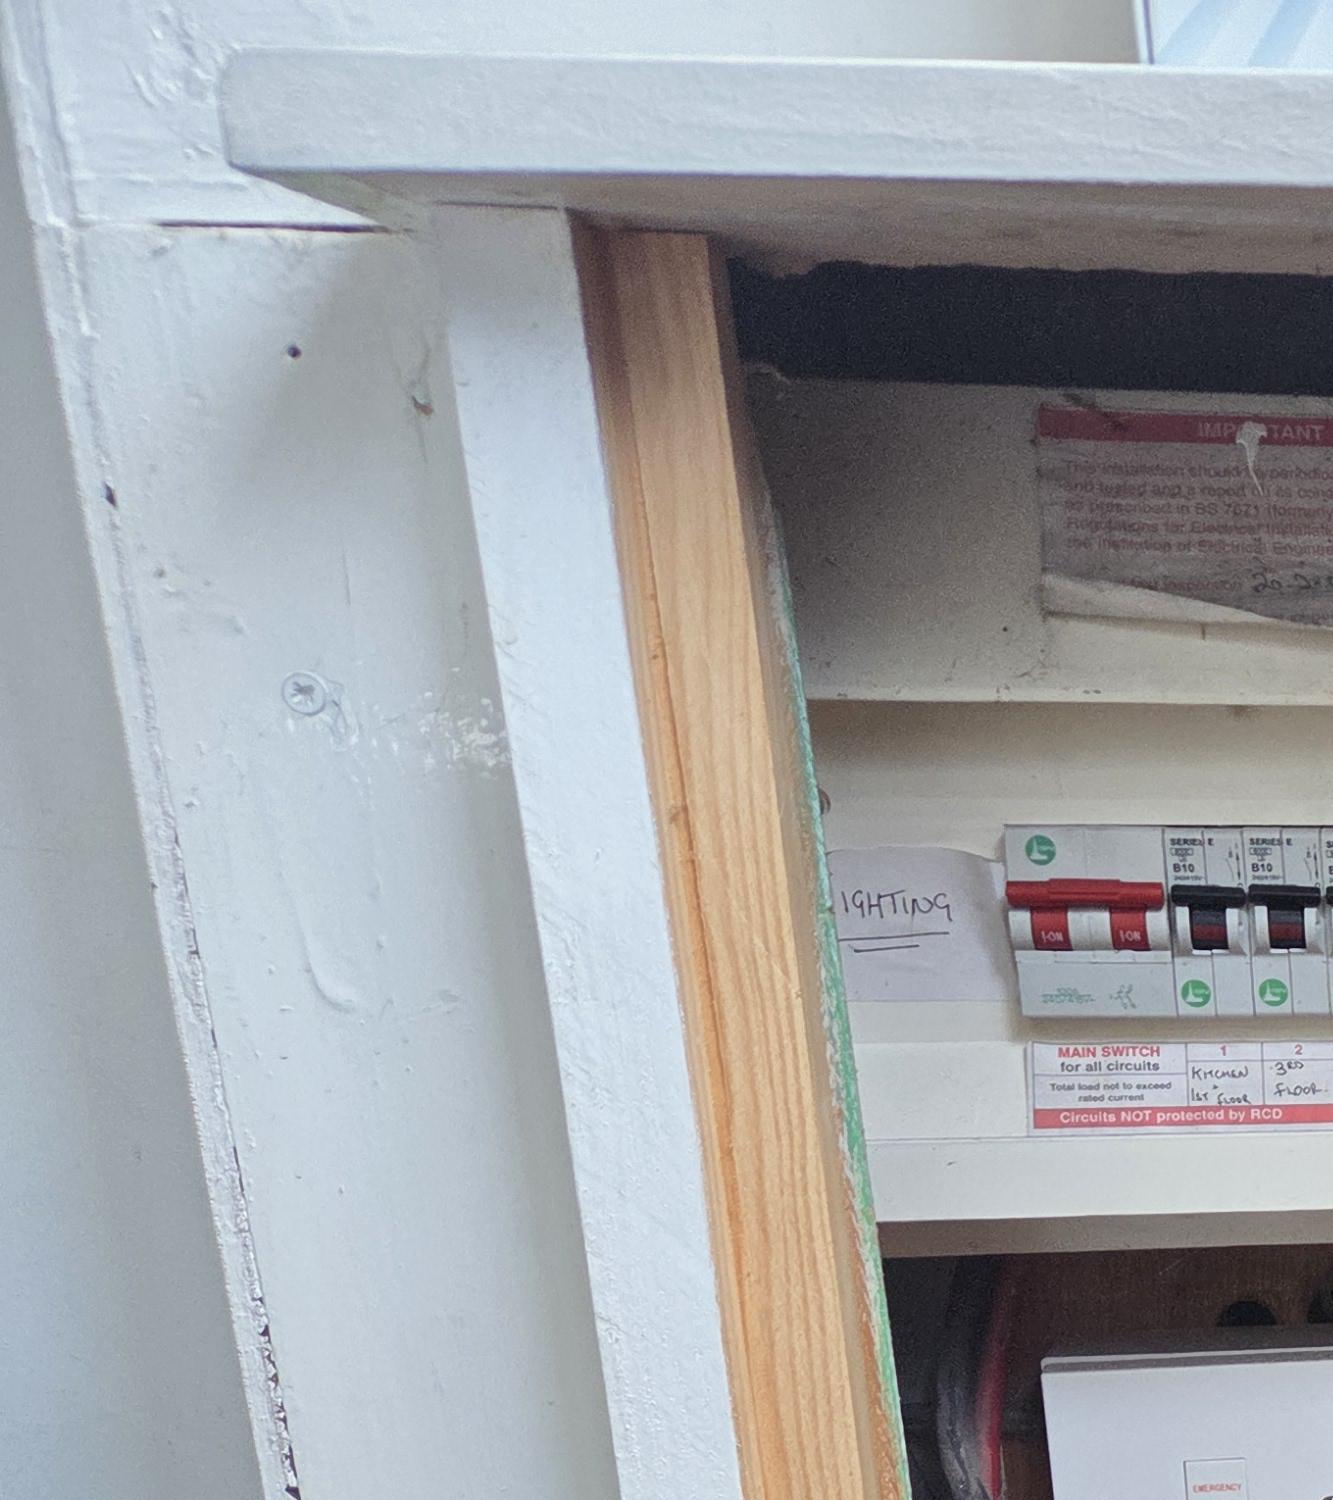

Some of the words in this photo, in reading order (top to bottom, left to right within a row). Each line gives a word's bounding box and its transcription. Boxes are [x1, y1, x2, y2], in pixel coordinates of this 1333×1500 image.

[1199, 422, 1324, 440] IMPTANT
[1173, 864, 1194, 872] B10
[1252, 864, 1273, 872] B10
[842, 889, 952, 922] IGHTING
[1058, 1046, 1097, 1058] MAIN
[1101, 1046, 1160, 1057] SWITCH
[1060, 1062, 1082, 1072] for
[1085, 1062, 1102, 1071] all
[1107, 1060, 1160, 1071] circuits
[1050, 1082, 1075, 1091] Total
[1078, 1082, 1101, 1090] load
[1104, 1082, 1120, 1090] not
[1136, 1080, 1172, 1090] exceed
[1078, 1094, 1105, 1102] rated
[1108, 1094, 1145, 1102] current
[1060, 1111, 1116, 1123] Circuits
[1121, 1110, 1152, 1122] NOT
[1156, 1108, 1224, 1122] protected
[1228, 1109, 1245, 1122] by
[1250, 1108, 1282, 1120] RCD
[1192, 1483, 1242, 1494] EMERGENCY
